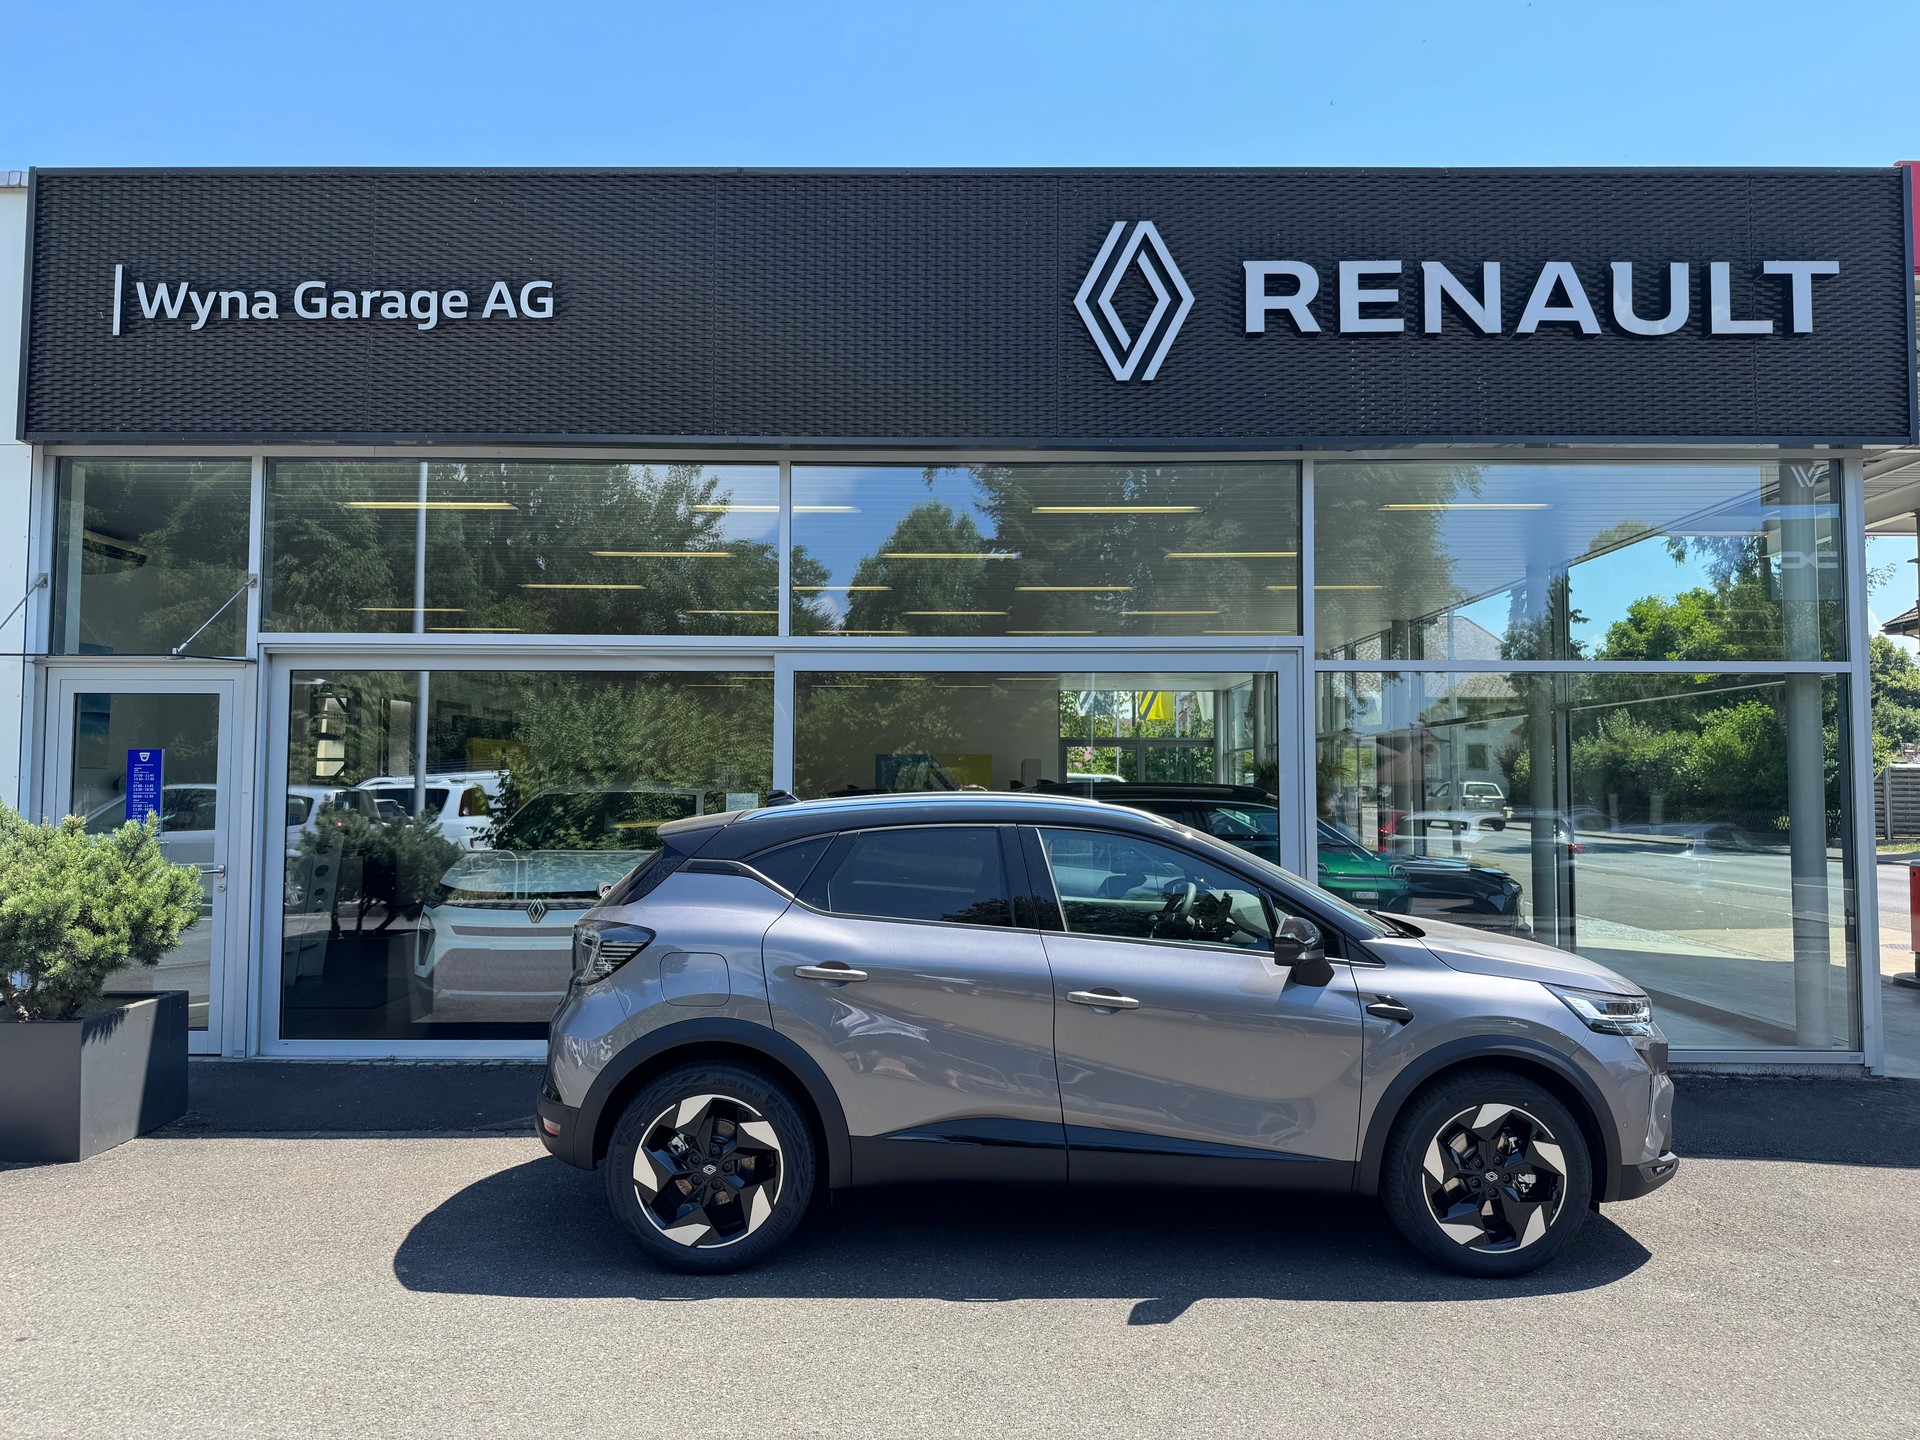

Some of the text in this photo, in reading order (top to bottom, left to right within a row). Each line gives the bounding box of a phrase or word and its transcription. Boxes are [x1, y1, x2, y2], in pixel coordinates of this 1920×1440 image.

[136, 281, 553, 330] Wyna Garage AG
[1243, 260, 1839, 335] RENAULT
[712, 1077, 738, 1088] 215/55
[739, 1083, 745, 1091] R
[745, 1086, 754, 1094] 18
